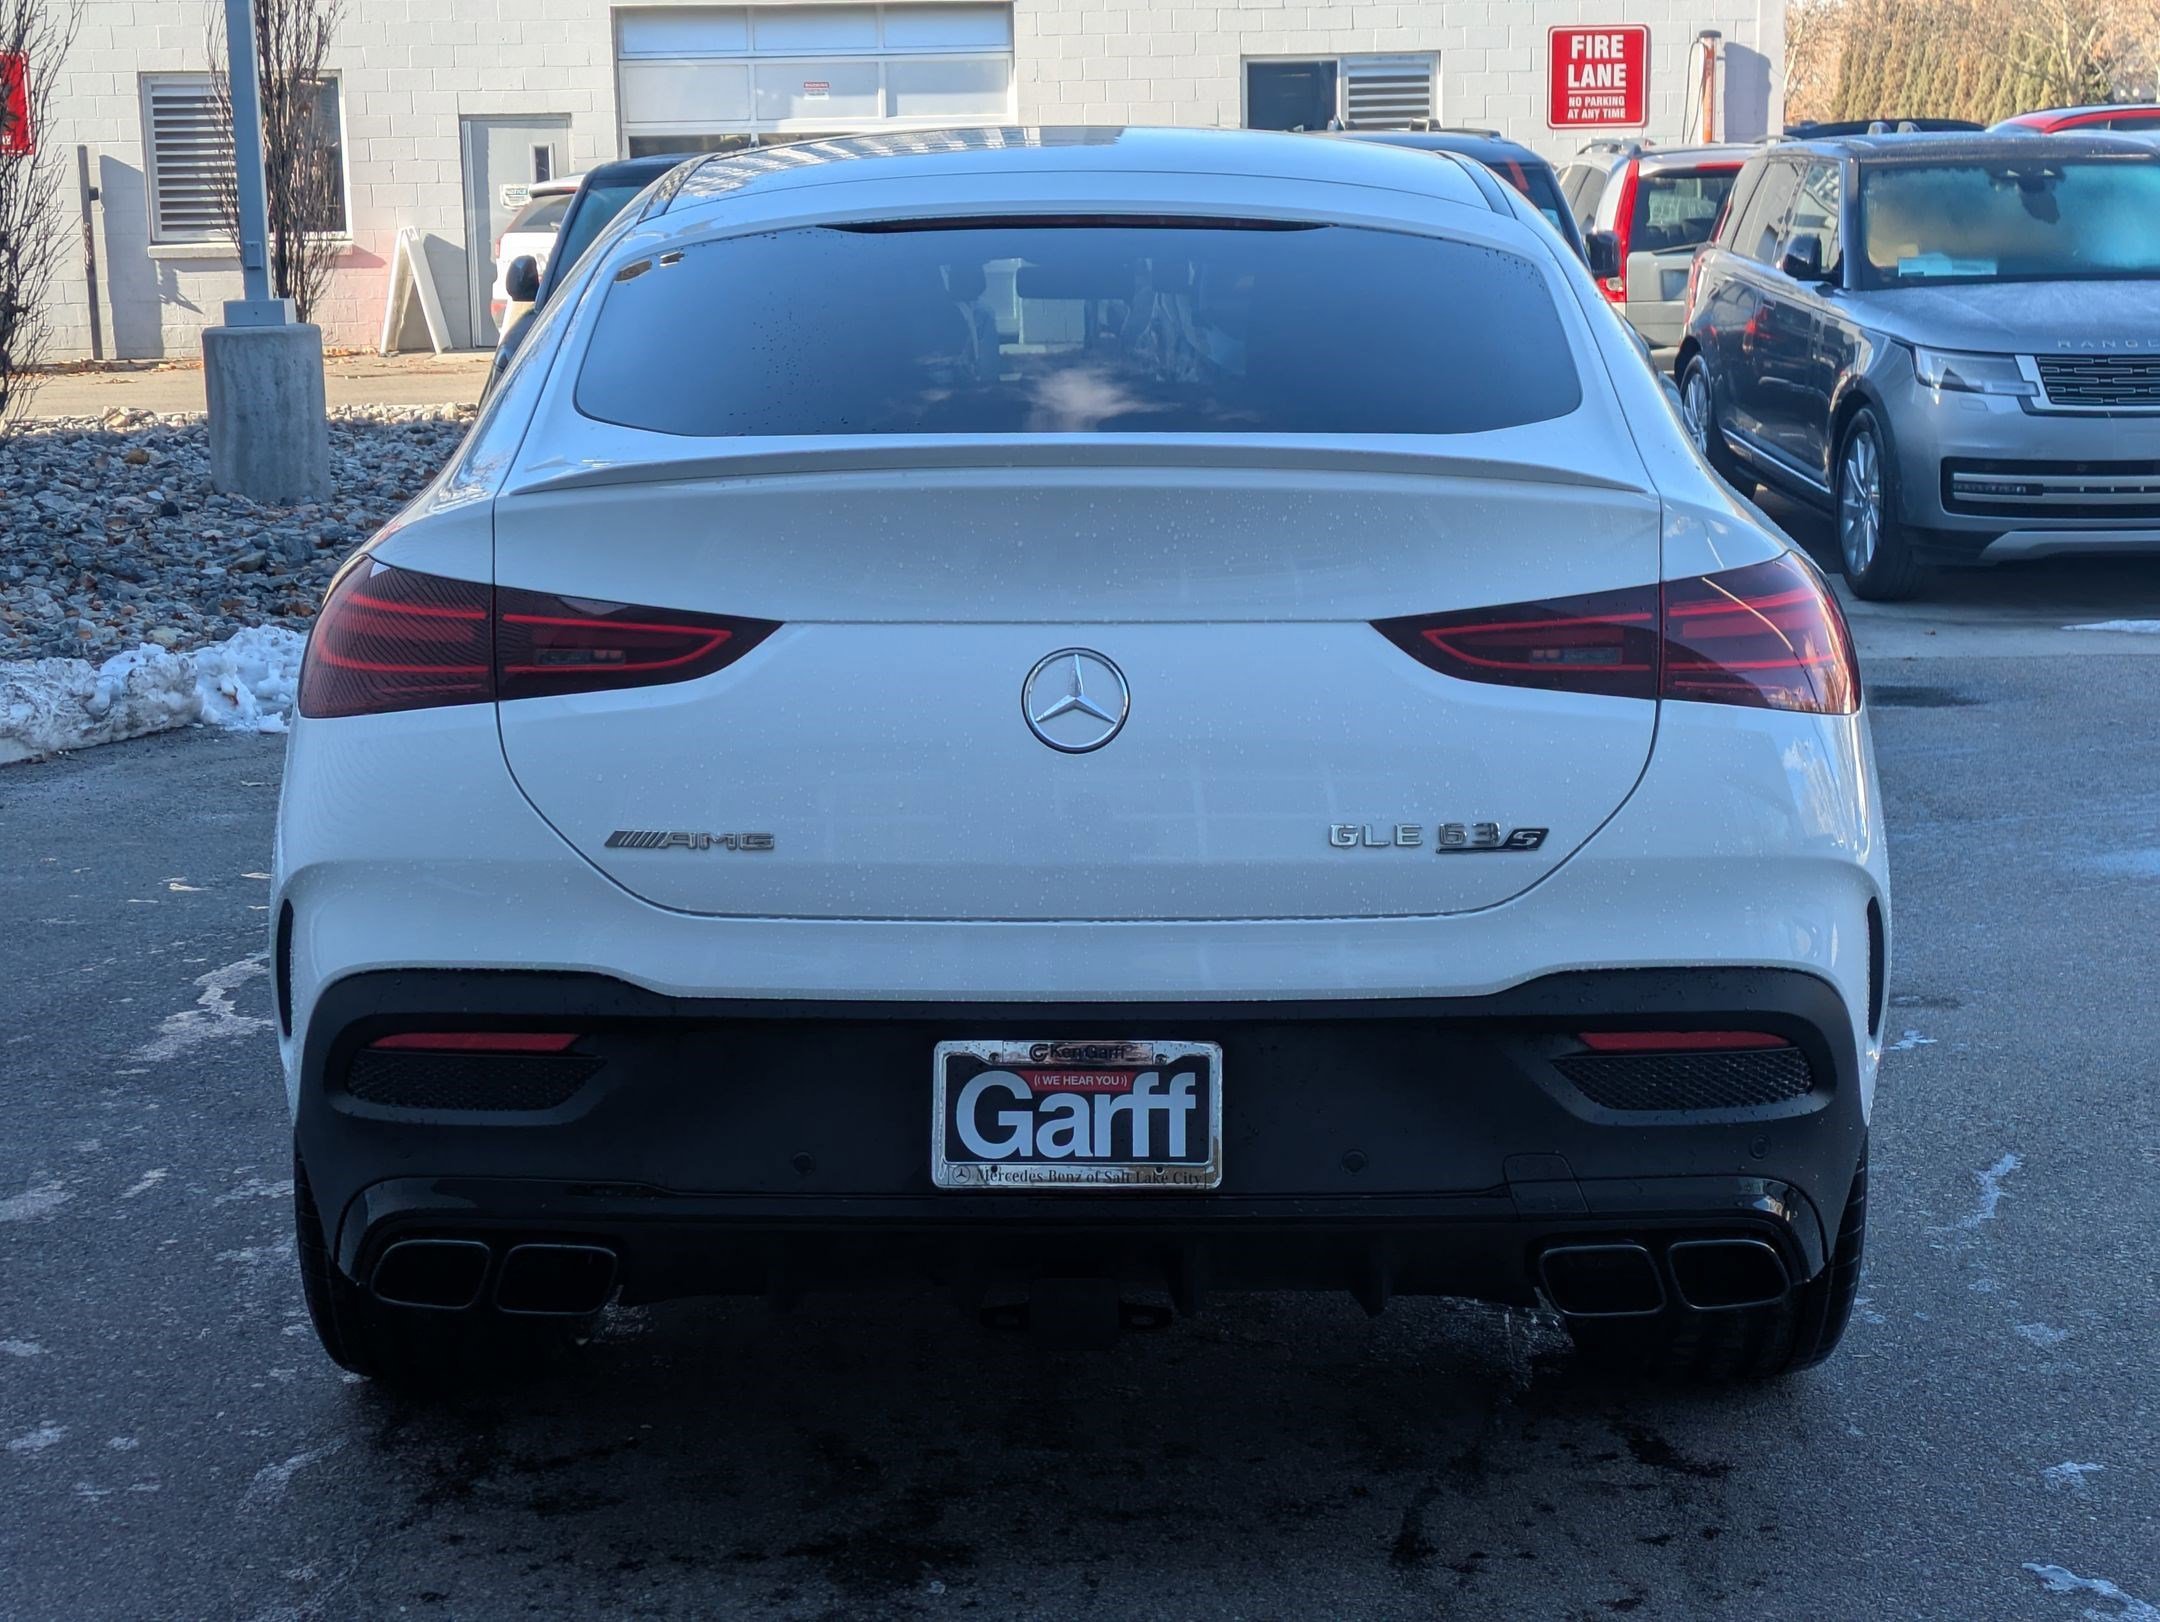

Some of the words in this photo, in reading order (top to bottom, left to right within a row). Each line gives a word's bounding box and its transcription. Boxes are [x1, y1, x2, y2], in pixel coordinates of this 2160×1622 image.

[1571, 34, 1624, 59] FIRE
[1567, 63, 1627, 88] LANE
[1568, 96, 1582, 107] NO
[1584, 95, 1625, 107] PARKING
[1567, 108, 1579, 120] AT
[1581, 108, 1601, 121] ANY
[1603, 108, 1626, 119] TIME
[659, 831, 775, 850] AMG
[1329, 822, 1423, 848] GLE
[1050, 1043, 1083, 1059] Ken
[1085, 1043, 1125, 1060] Garff
[1043, 1075, 1061, 1086] WE
[1063, 1075, 1093, 1086] HEAR
[1095, 1075, 1119, 1086] YOU
[956, 1070, 1196, 1159] Garff
[1086, 1169, 1100, 1183] of
[1104, 1169, 1131, 1184] Salt
[1136, 1170, 1168, 1184] Lake
[1173, 1170, 1202, 1189] City
